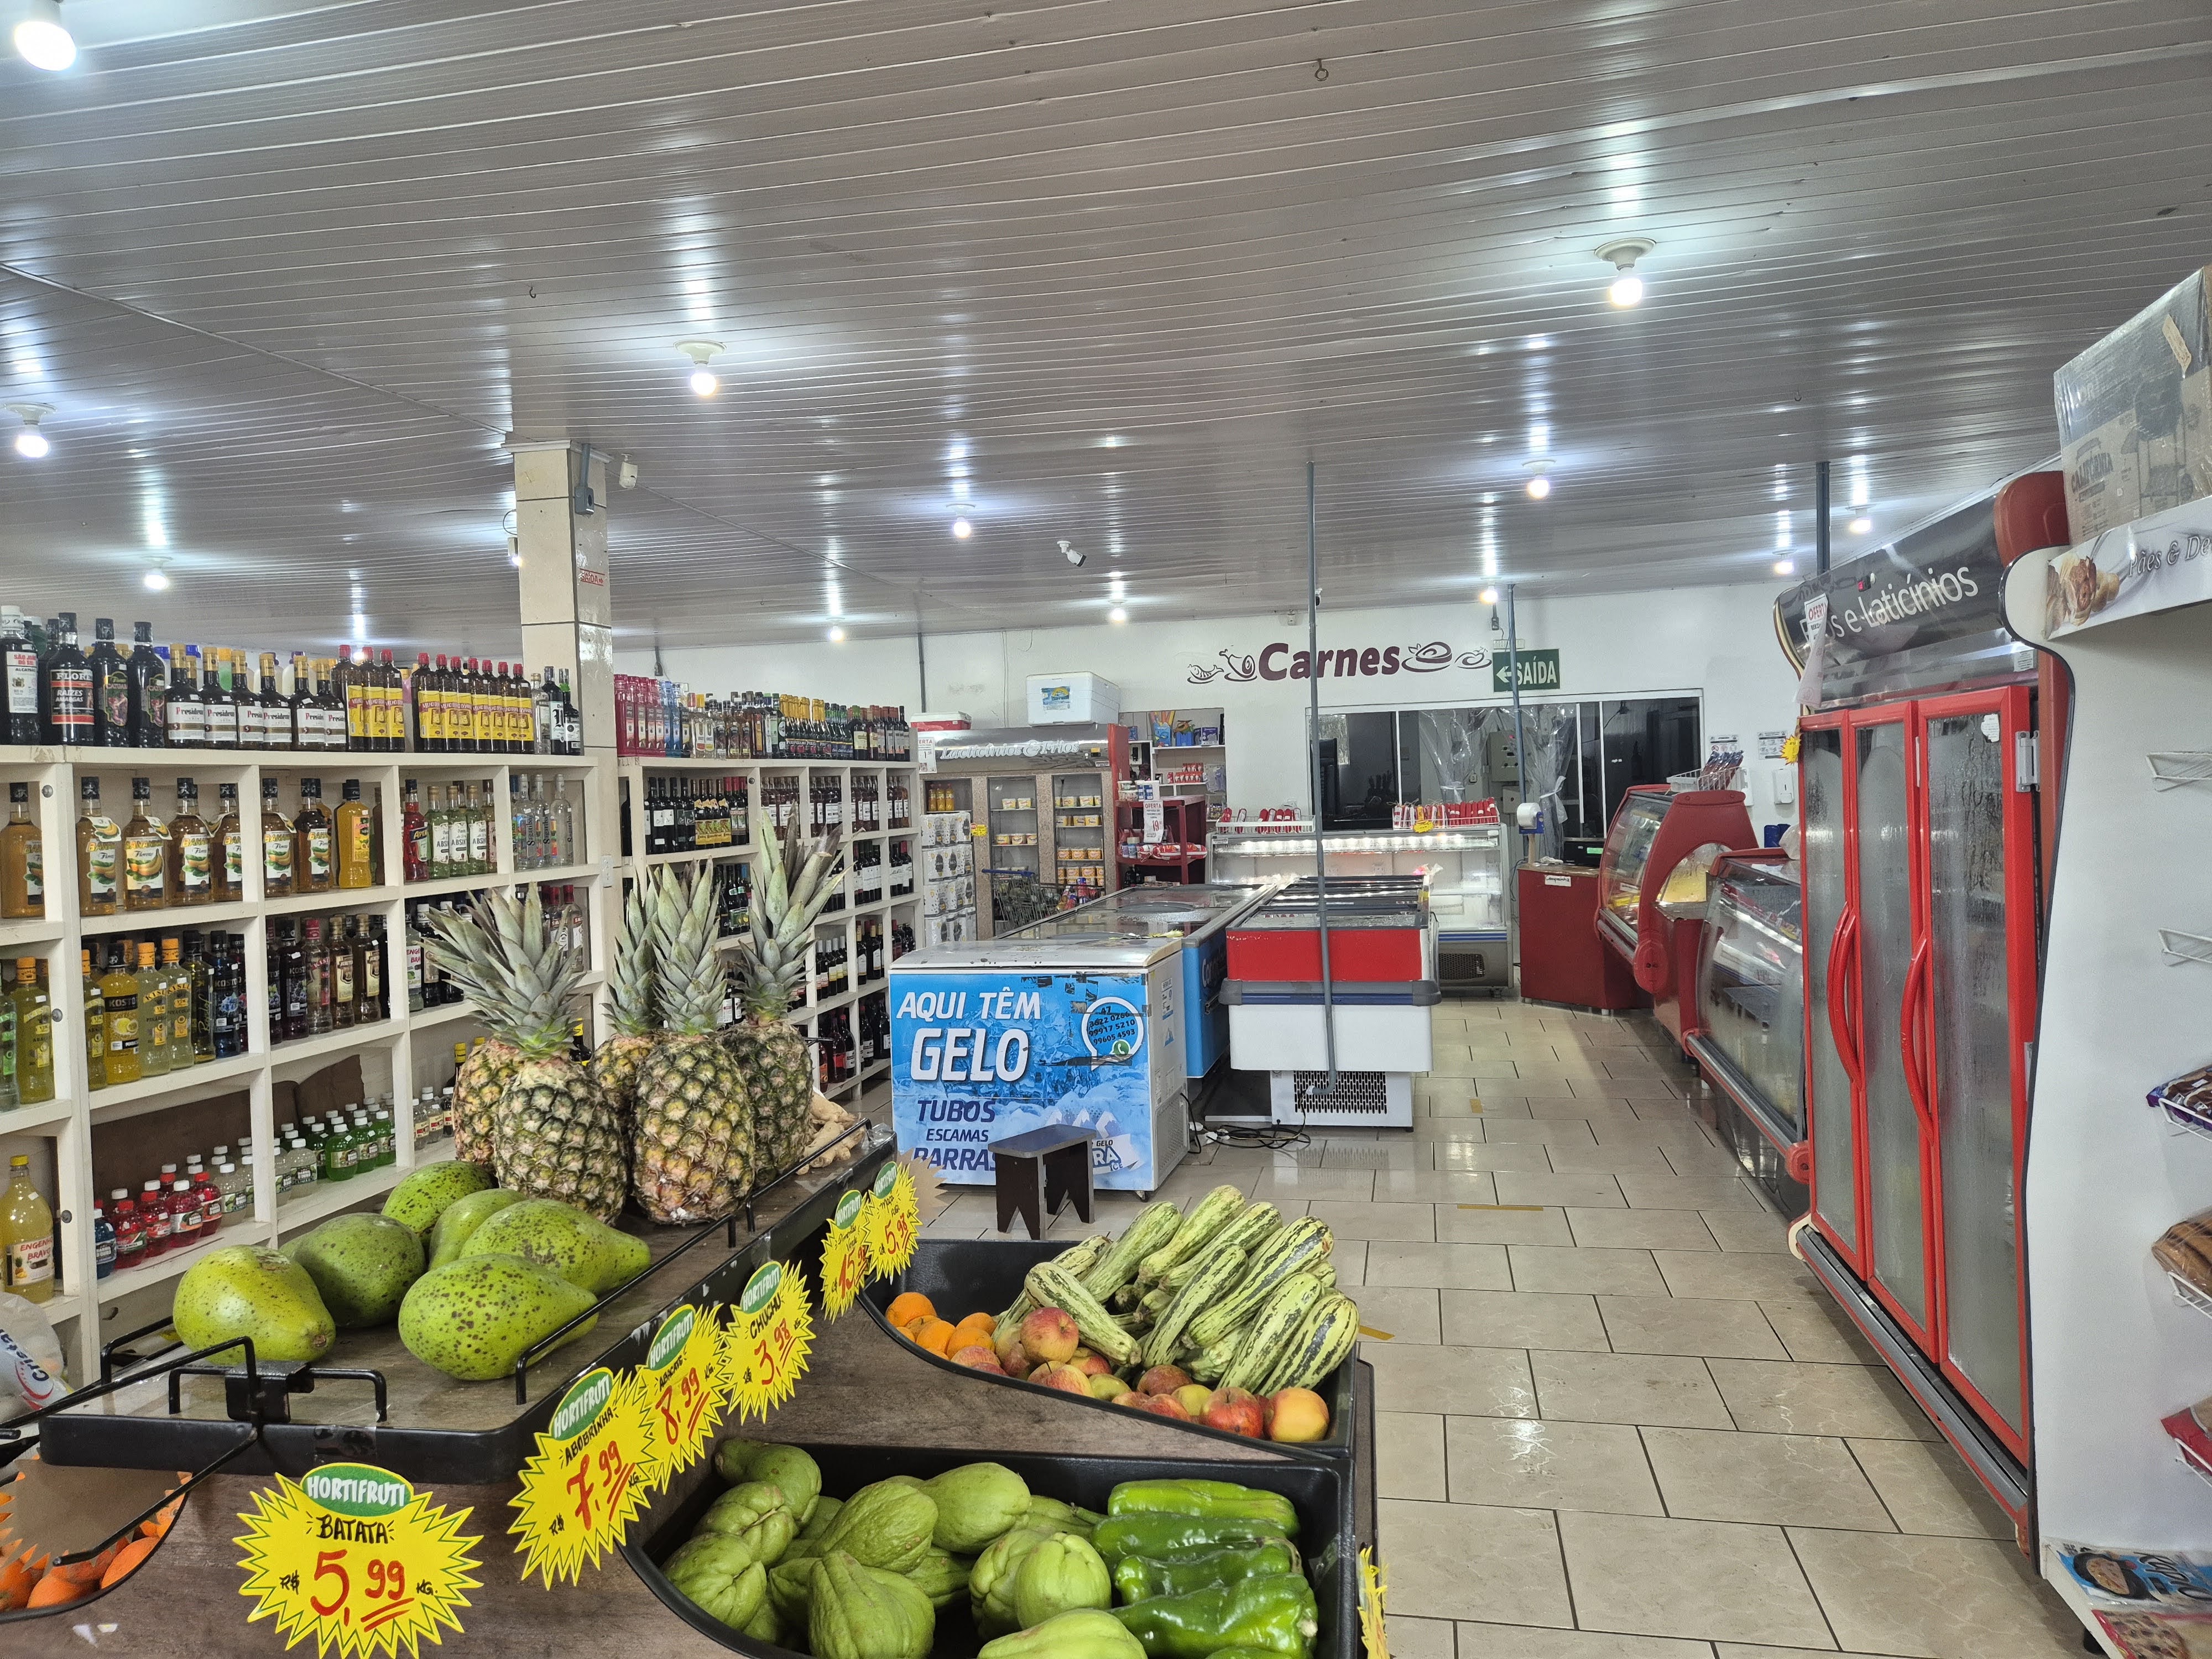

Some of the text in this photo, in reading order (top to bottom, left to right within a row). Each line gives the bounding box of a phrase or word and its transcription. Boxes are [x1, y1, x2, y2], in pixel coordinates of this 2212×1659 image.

[2129, 534, 2212, 577] Pães & De
[1844, 609, 1863, 633] e
[1858, 567, 1979, 628] Laticínios
[1259, 643, 1400, 681] Carnes
[1516, 658, 1557, 685] SAÍDA
[1023, 739, 1040, 757] &
[1040, 740, 1079, 755] Frios
[1152, 820, 1160, 831] 19
[896, 987, 1041, 1022] AQUI TÊM
[1100, 1005, 1112, 1015] 47
[1110, 1011, 1130, 1021] 0266
[1089, 1019, 1135, 1037] 99917 5210
[1093, 1029, 1135, 1045] 99605 4593
[911, 1028, 1029, 1081] GELO
[917, 1099, 995, 1123] TUBOS
[926, 1129, 989, 1142] ESCAMAS
[1092, 1146, 1121, 1166] RA
[1109, 1162, 1123, 1171] ICE
[875, 1165, 897, 1197] HORTIFRUTI
[836, 1194, 860, 1227] HORTIFRUTI
[28, 1248, 51, 1260] BRAVO
[743, 1266, 780, 1312] HORTIFRUTI
[750, 1292, 781, 1340] CHUCHU
[650, 1311, 693, 1369] HORTIFRUTI
[754, 1318, 791, 1385] 3,98
[659, 1355, 683, 1392] ABACATE
[554, 1374, 611, 1439] HORTIFRUTI
[307, 1475, 405, 1507] HORTIFRUTI
[549, 1512, 565, 1537] R$
[566, 1441, 622, 1531] 7,99
[316, 1514, 388, 1544] BATATA
[279, 1548, 438, 1626] R$ 5,99 KG.
